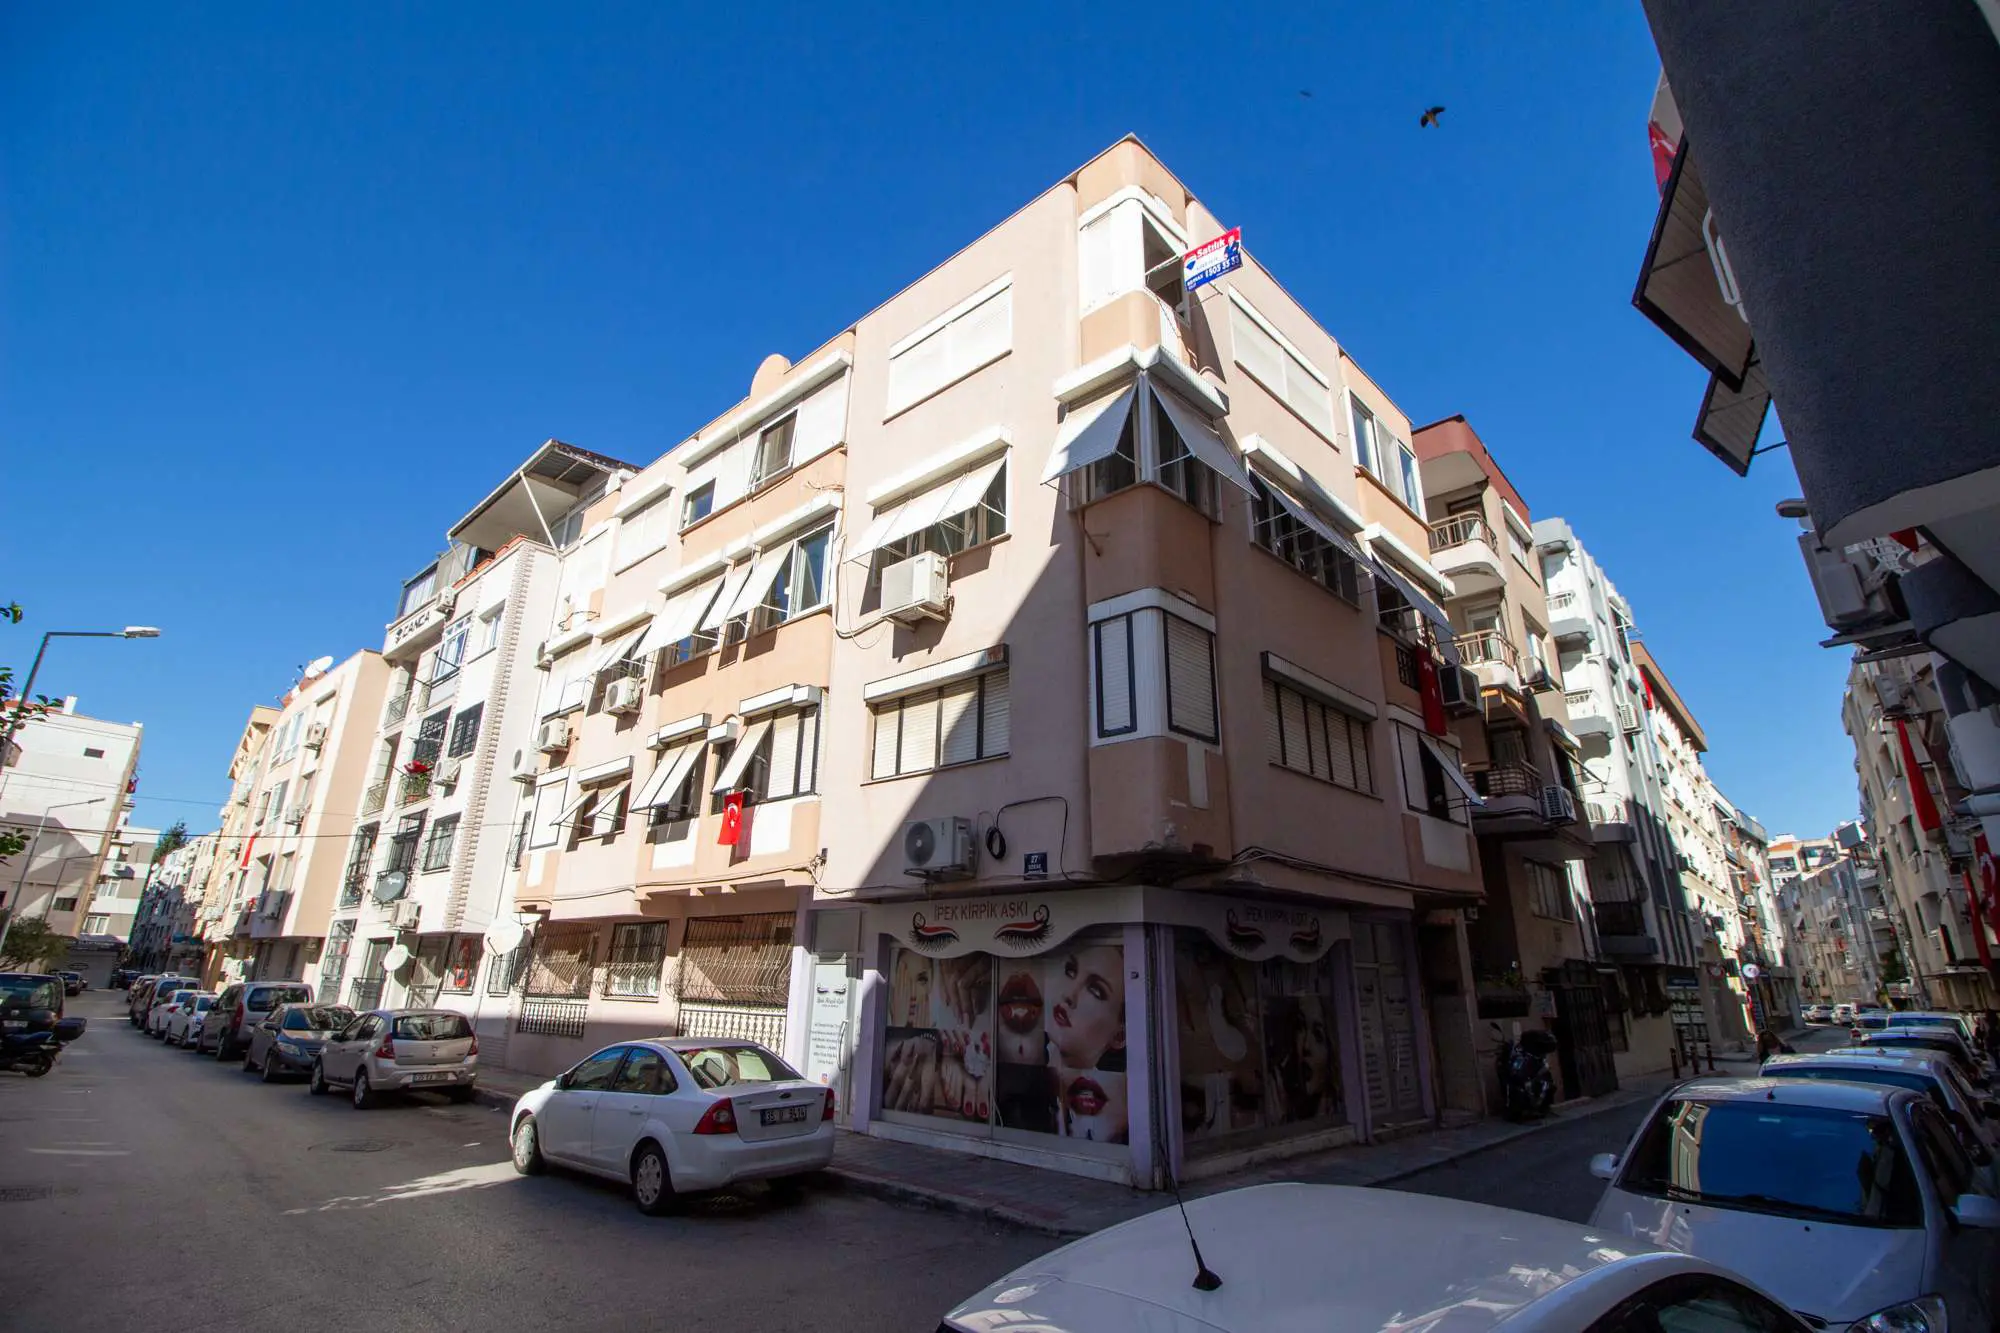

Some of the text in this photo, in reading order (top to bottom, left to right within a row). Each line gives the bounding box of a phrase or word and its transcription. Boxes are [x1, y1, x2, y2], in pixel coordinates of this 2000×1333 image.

[934, 900, 1028, 921] İPEK KİRPİK AŞKI
